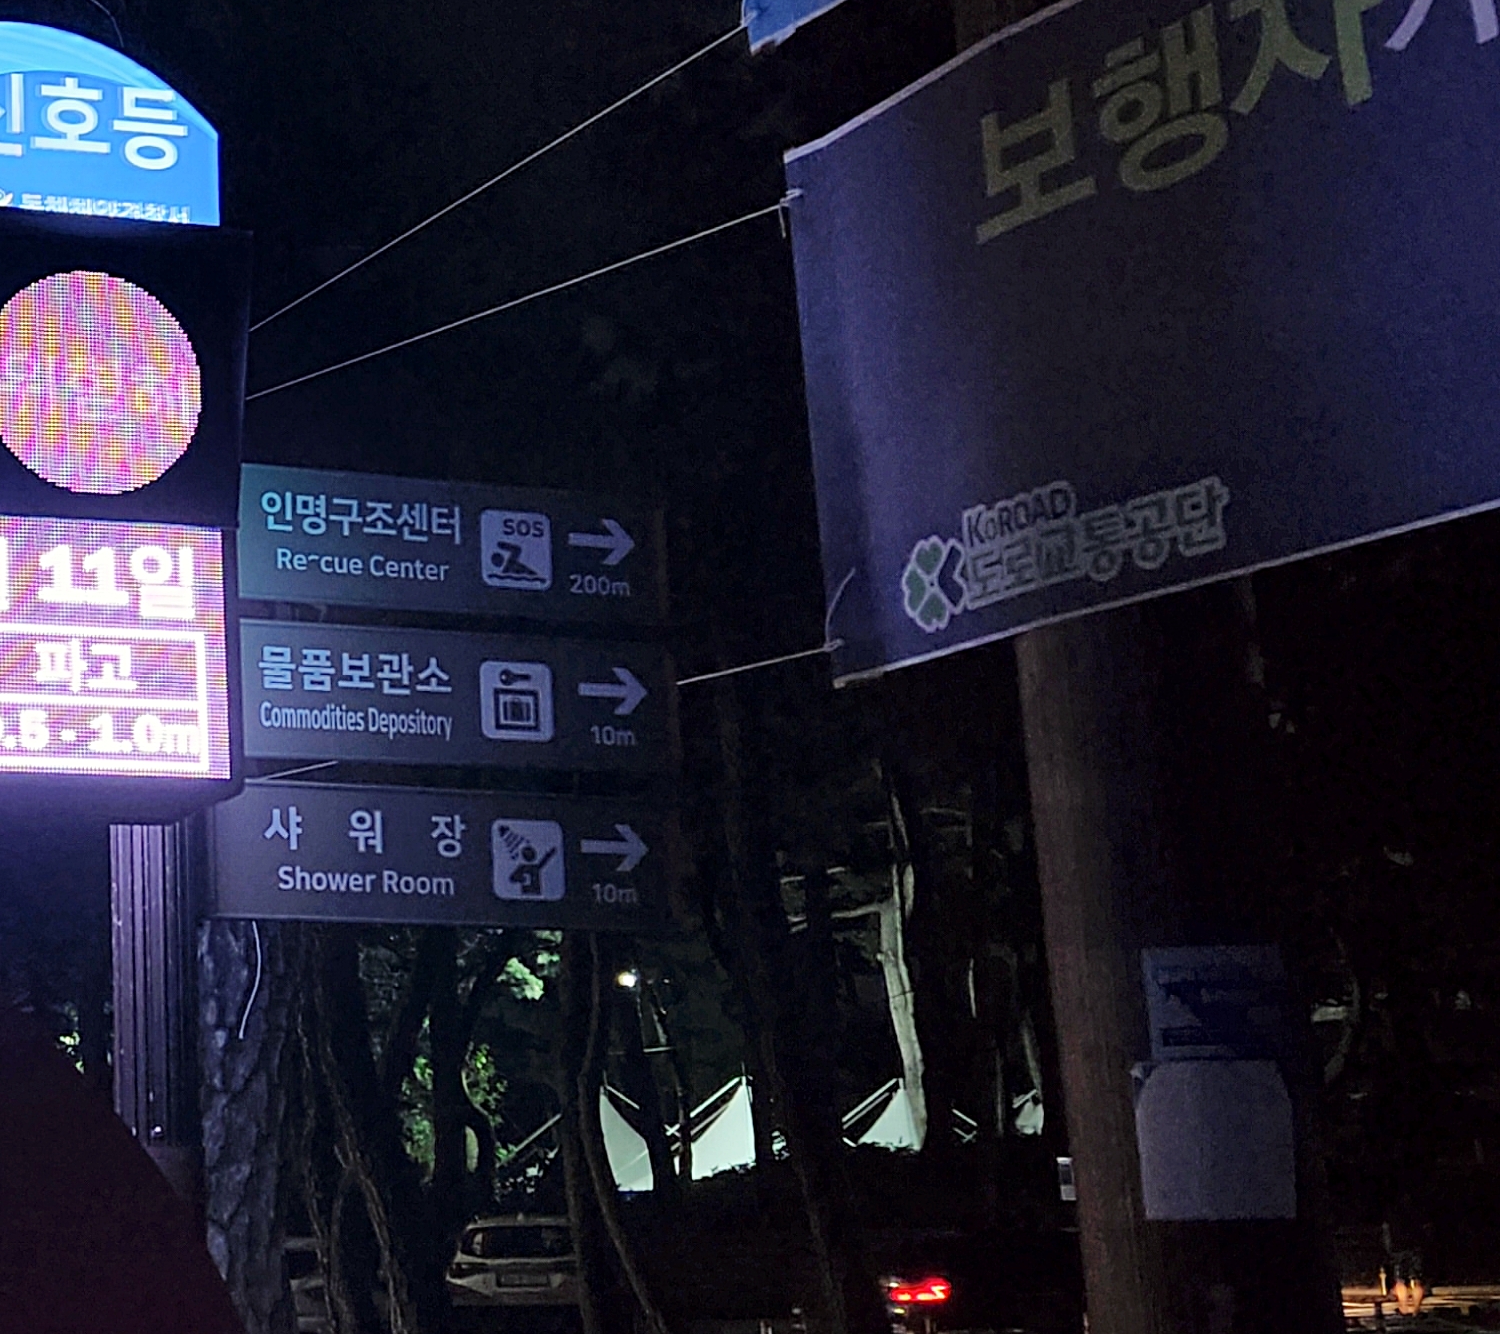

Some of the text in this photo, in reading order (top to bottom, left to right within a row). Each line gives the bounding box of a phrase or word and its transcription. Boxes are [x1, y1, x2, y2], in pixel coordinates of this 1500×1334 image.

[261, 492, 461, 544] 인명구조센터
[503, 518, 545, 537] SOS
[967, 478, 1228, 608] 도로교통공단
[37, 543, 196, 621] 11일
[370, 555, 449, 581] Center
[569, 574, 631, 596] 200m
[34, 638, 137, 694] 파고
[258, 646, 452, 695] 물품보관소
[260, 701, 452, 740] Commodities Depository
[592, 726, 635, 746] 10m
[278, 866, 454, 895] Shower Room
[592, 884, 637, 904] 10m
